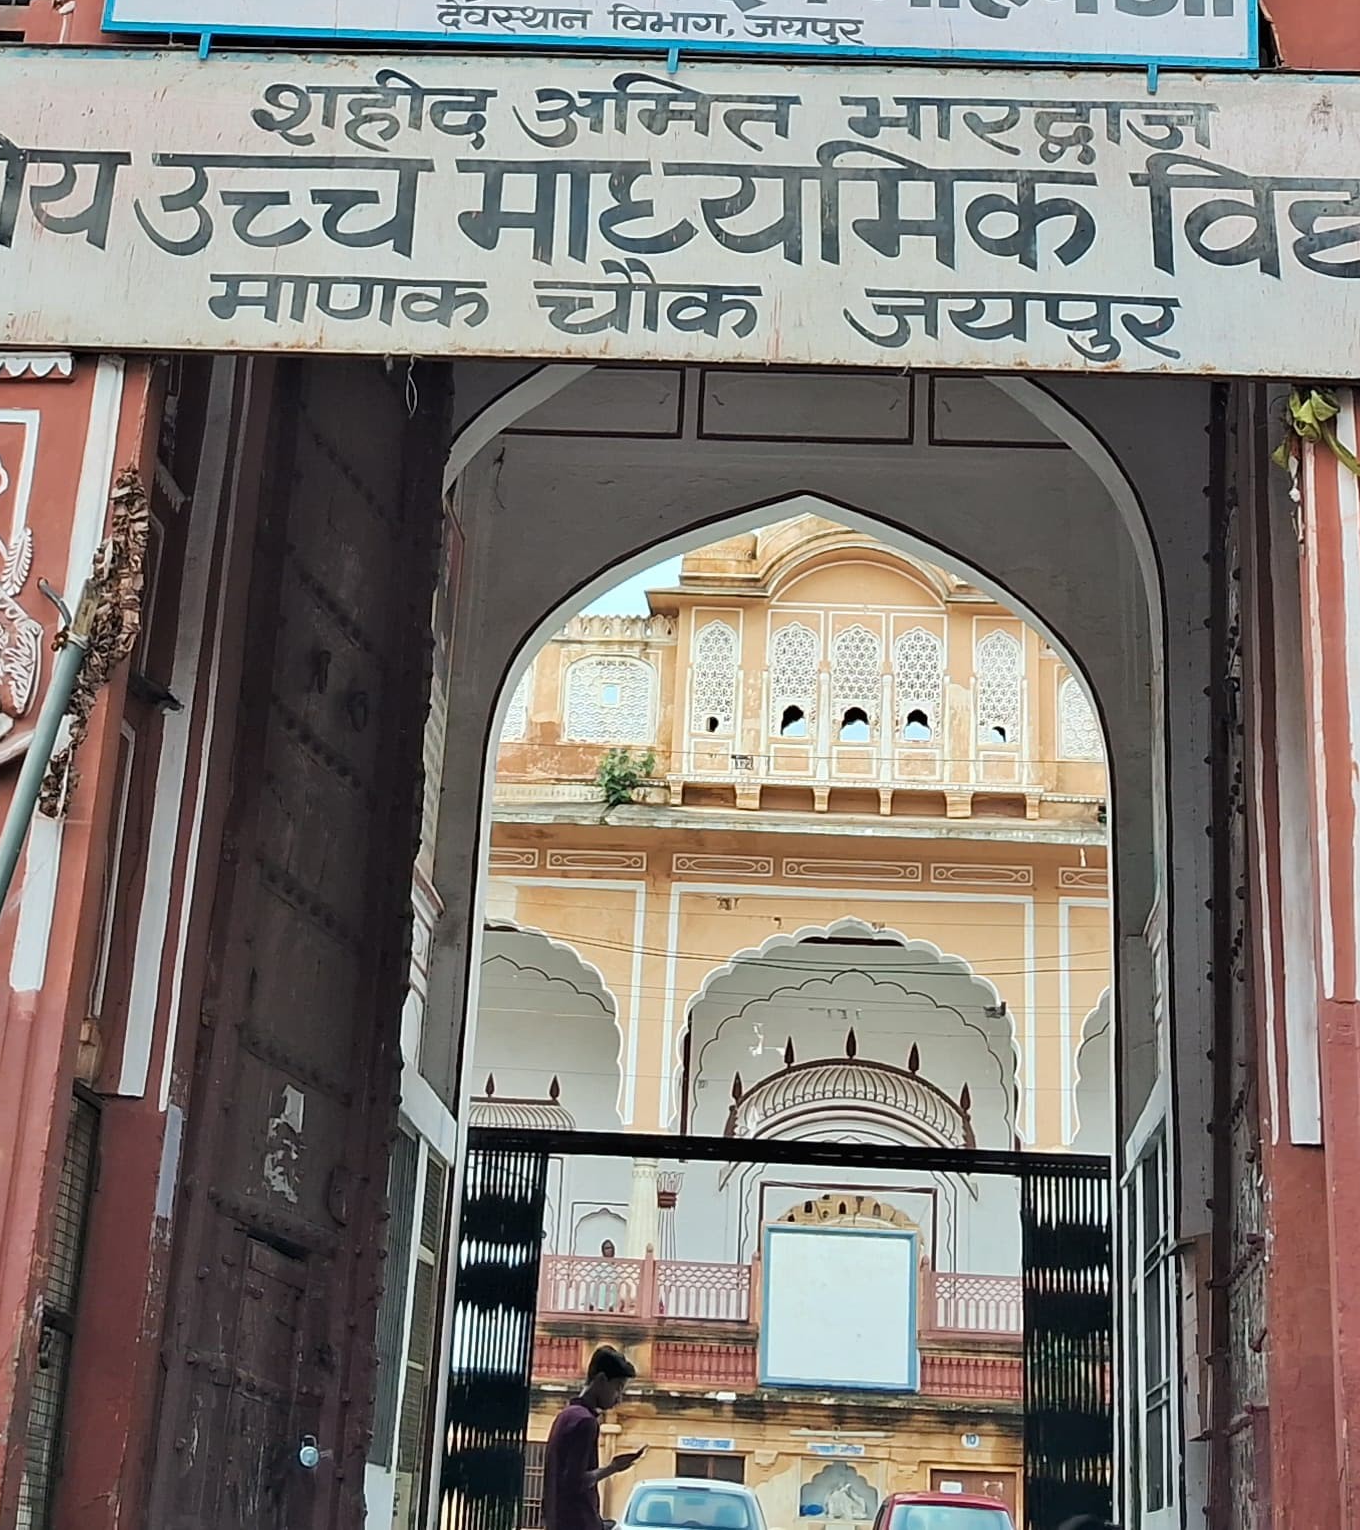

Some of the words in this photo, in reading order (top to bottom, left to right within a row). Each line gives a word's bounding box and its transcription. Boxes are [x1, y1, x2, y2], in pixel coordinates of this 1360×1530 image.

[743, 14, 864, 45] जयपुर
[251, 69, 498, 152] शहीद
[512, 72, 802, 152] अमित
[839, 95, 1220, 165] भारद्वाज
[134, 152, 436, 259] उच्च
[455, 140, 1099, 271] माध्यमिक
[208, 273, 490, 330] माणक
[533, 258, 764, 338] चौक
[843, 287, 1183, 363] जयपुर
